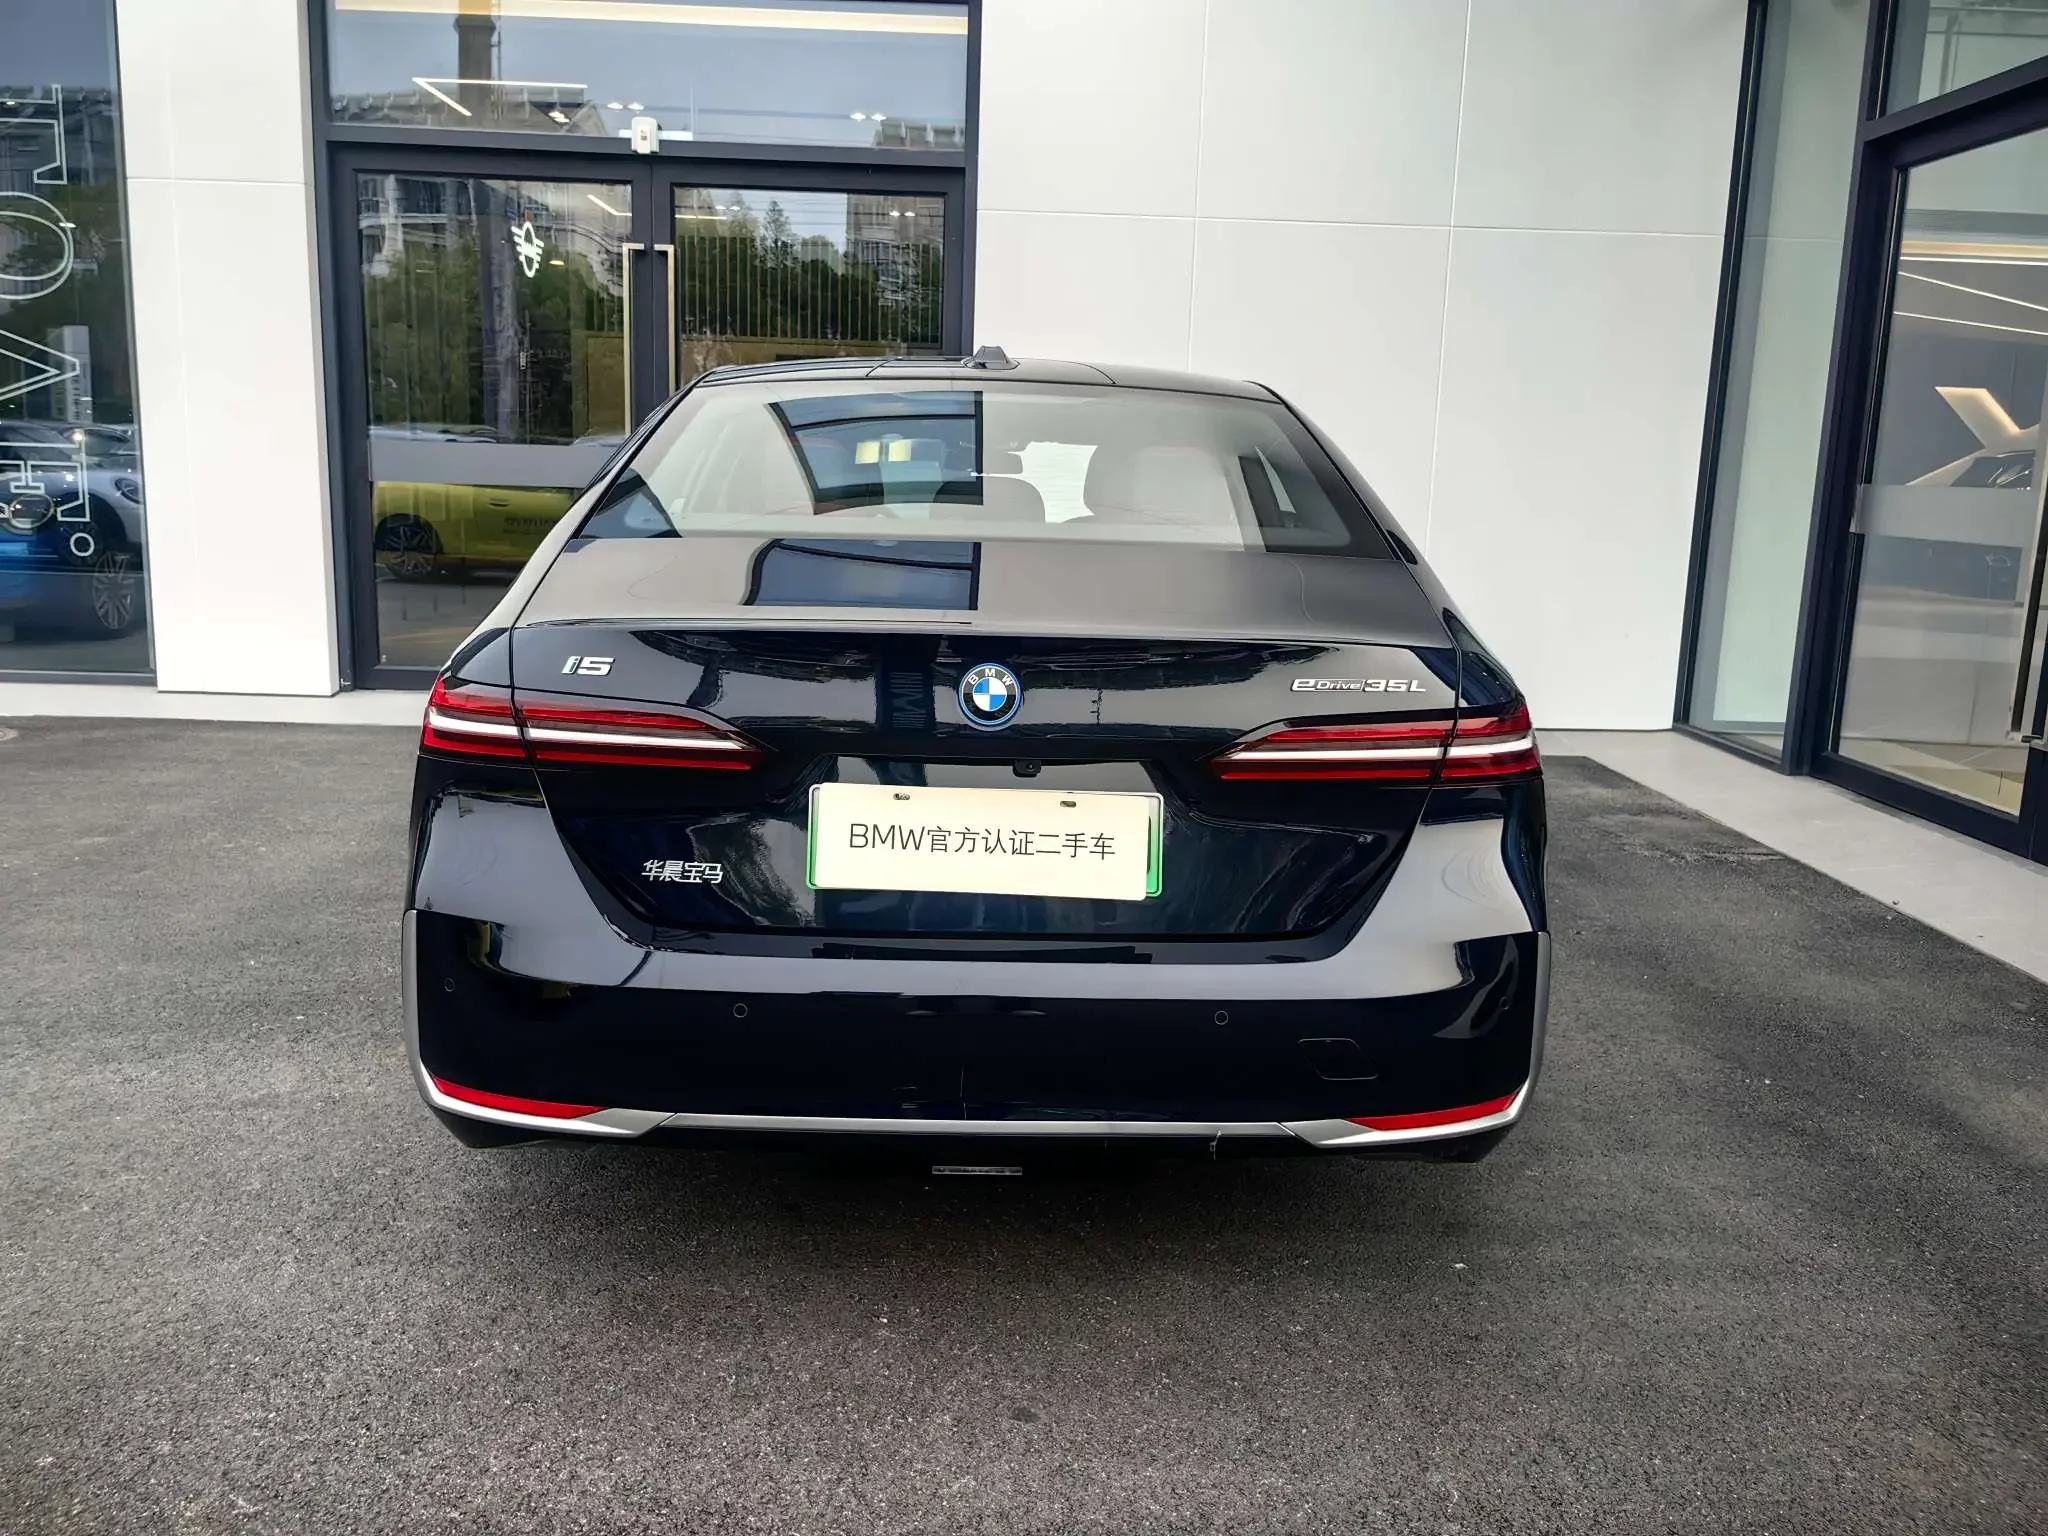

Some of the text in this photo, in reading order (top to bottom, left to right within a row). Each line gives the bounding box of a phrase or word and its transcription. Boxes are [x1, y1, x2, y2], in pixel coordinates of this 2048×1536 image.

[561, 655, 616, 676] i5
[968, 668, 1013, 686] BMW
[848, 822, 1116, 861] BMW官方认证二手车
[641, 859, 724, 884] 华晨宝马
